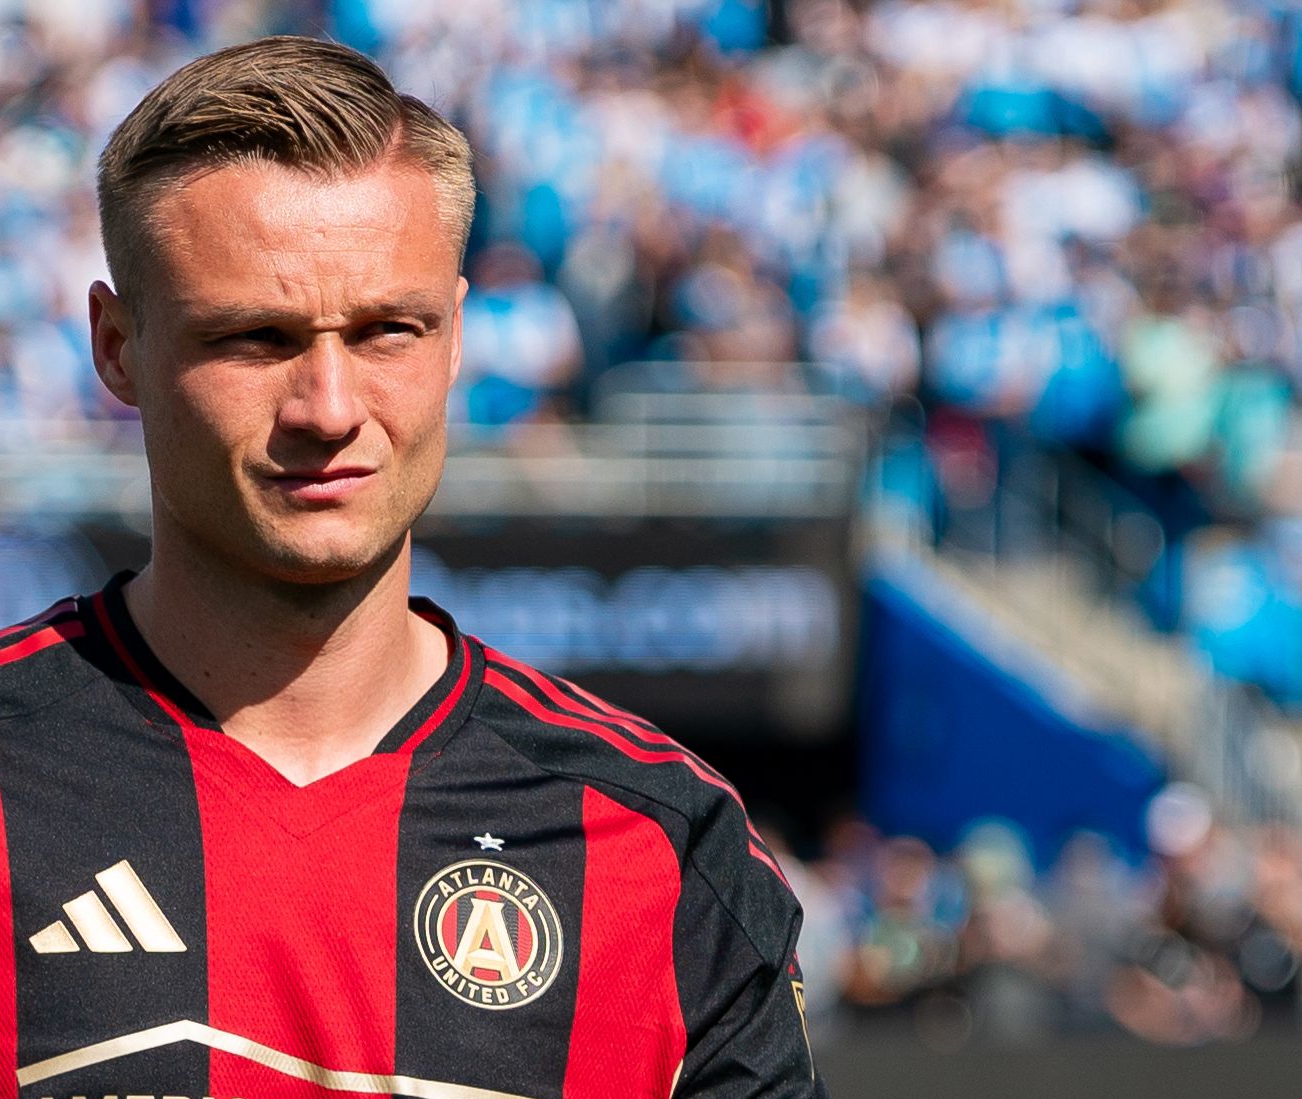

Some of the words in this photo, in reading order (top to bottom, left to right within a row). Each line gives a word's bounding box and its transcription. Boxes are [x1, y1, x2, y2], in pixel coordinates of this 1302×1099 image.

[437, 867, 540, 911] ATLANTA
[453, 897, 520, 982] A
[432, 955, 510, 1004] UNITED
[515, 970, 544, 997] FC
